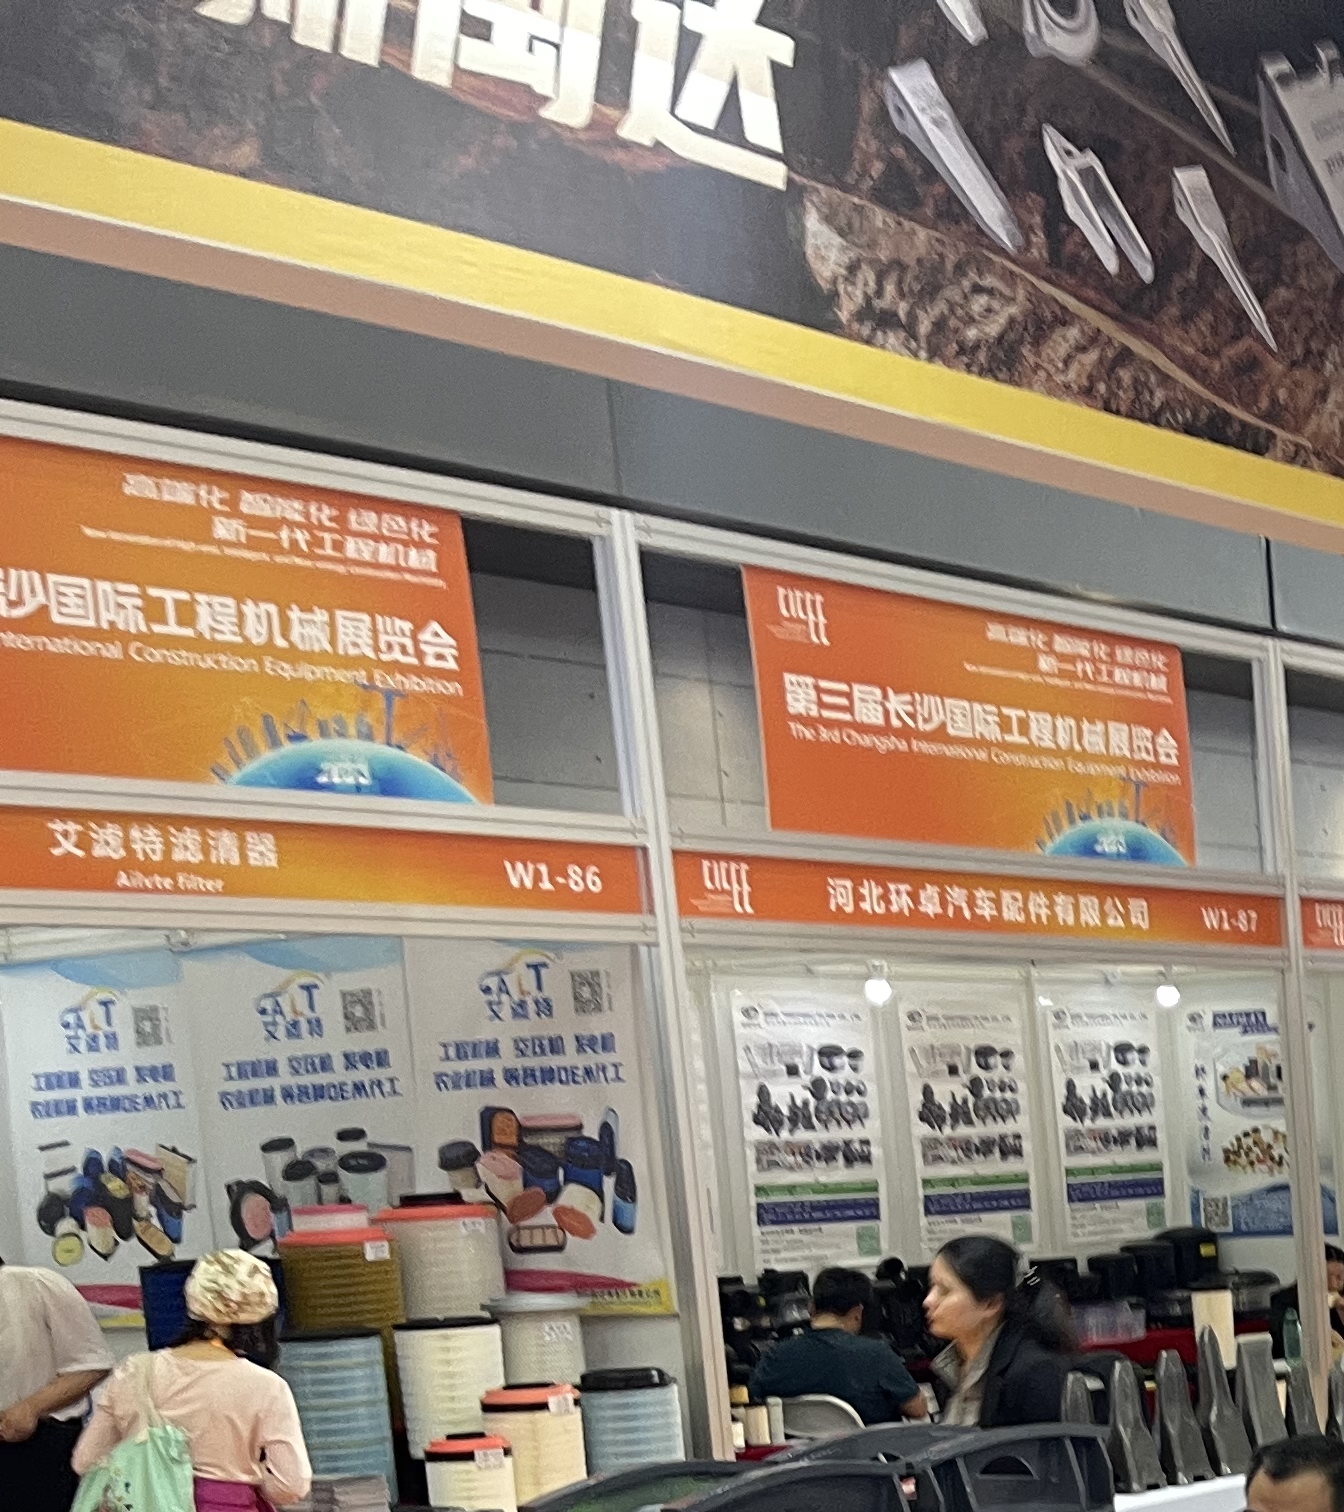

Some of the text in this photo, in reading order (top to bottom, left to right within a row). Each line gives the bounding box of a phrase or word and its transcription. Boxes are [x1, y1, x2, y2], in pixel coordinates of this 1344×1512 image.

[238, 488, 340, 530] 智能化
[211, 515, 440, 573] 新一代工程机械
[128, 641, 260, 676] Construction
[372, 669, 464, 697] Exhibition
[781, 671, 1181, 769] 第三届长沙国际工程机械展览会
[787, 719, 817, 742] The
[503, 859, 604, 894] W1-86
[1200, 904, 1259, 935] W1-87
